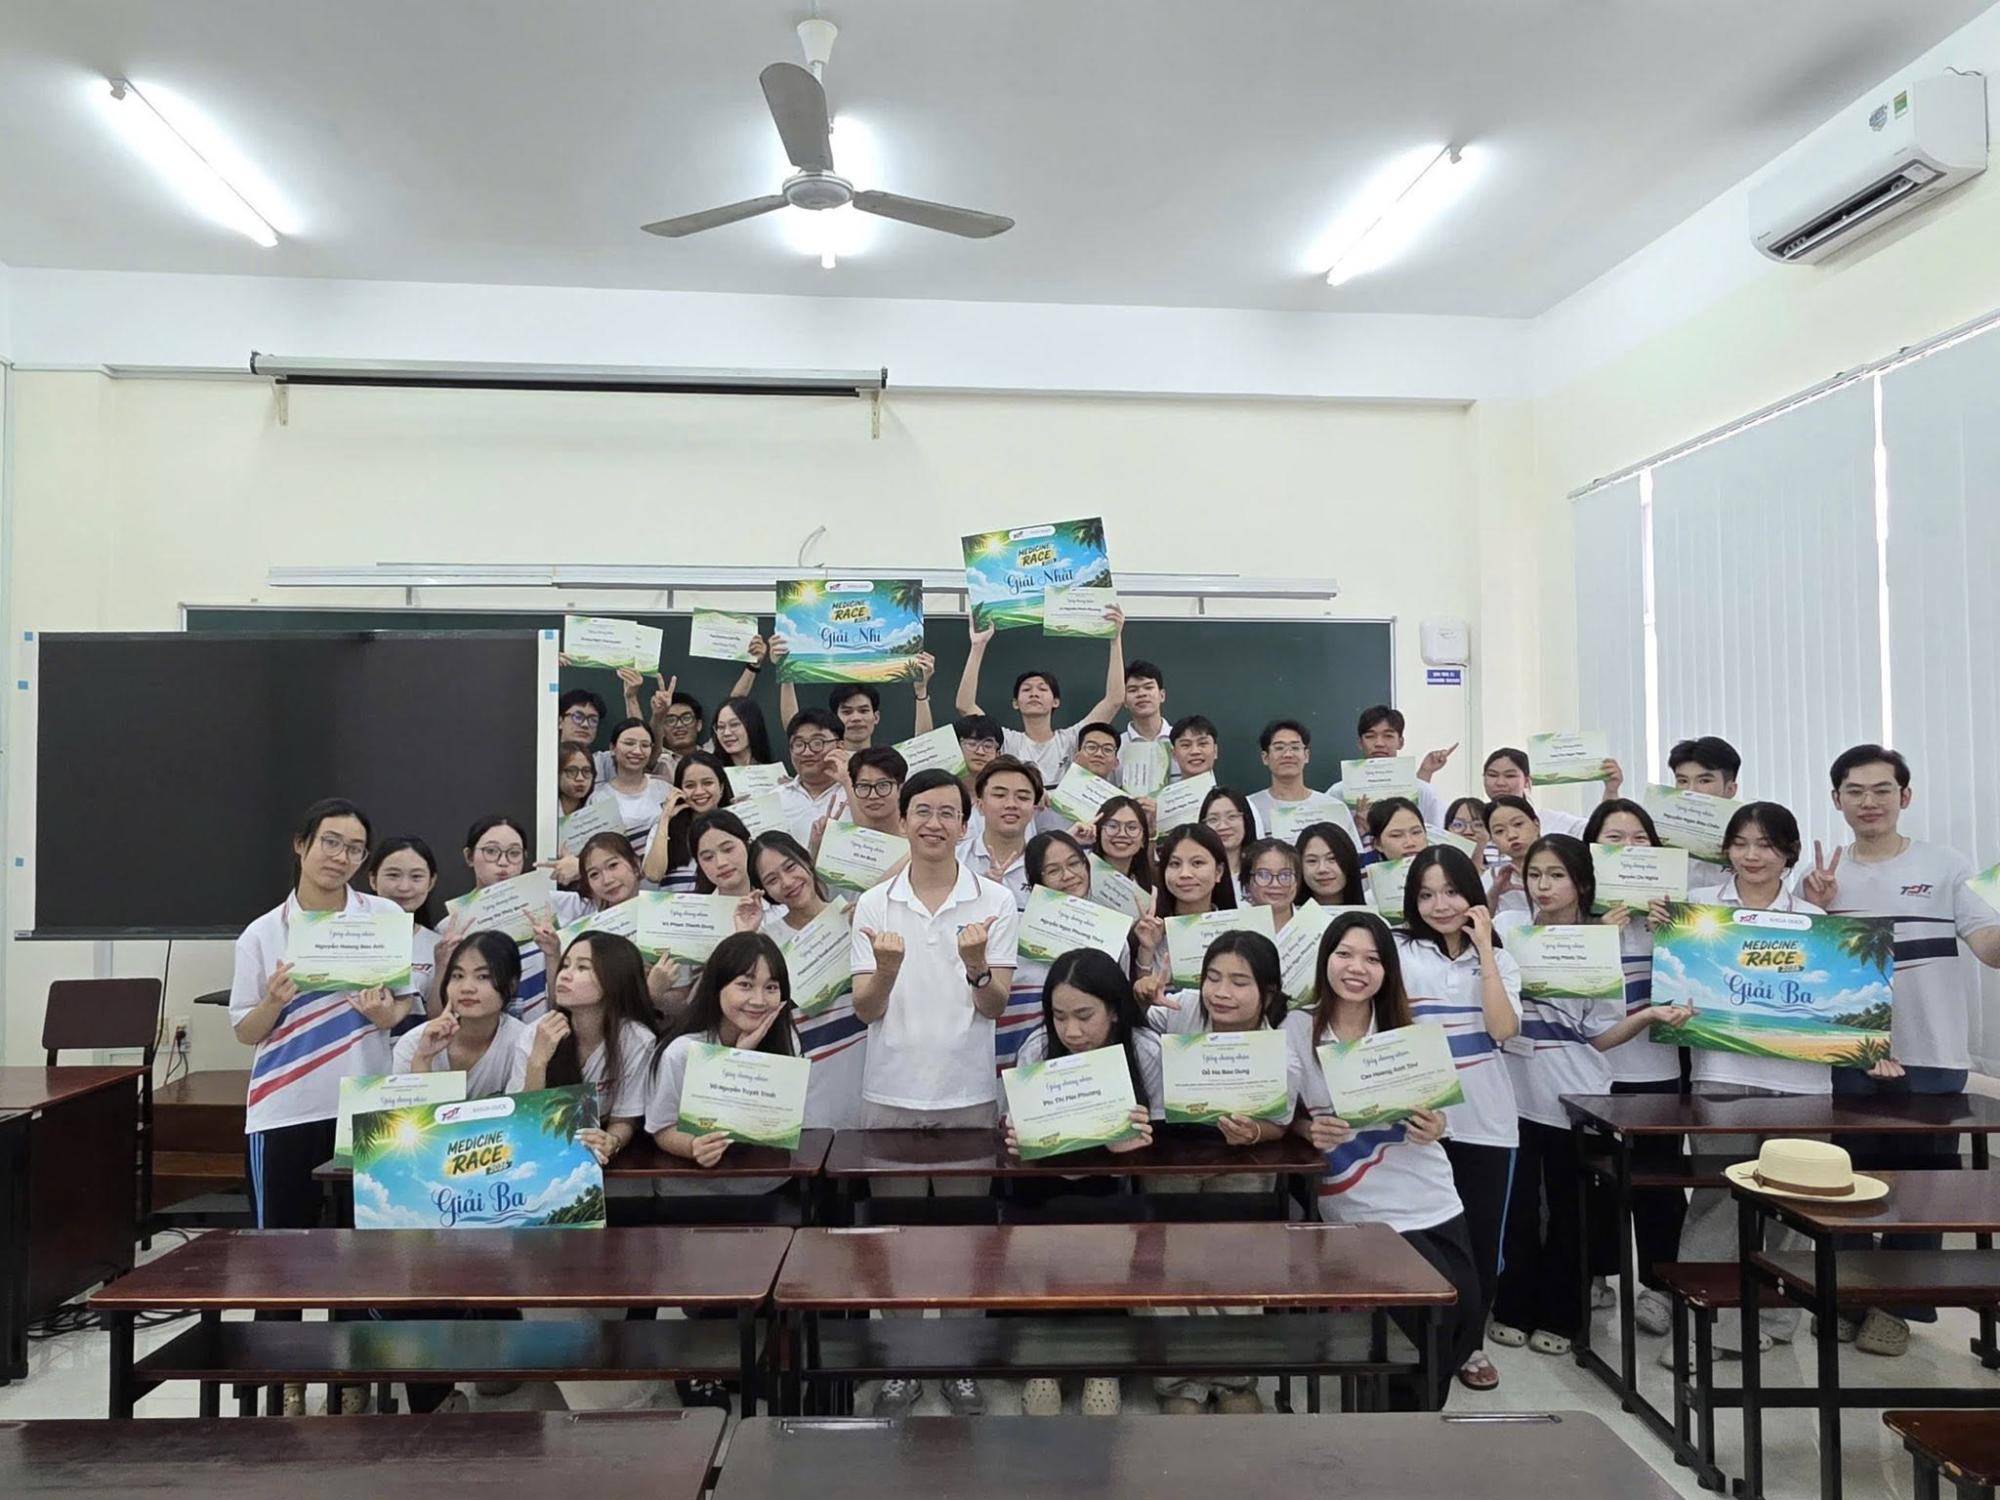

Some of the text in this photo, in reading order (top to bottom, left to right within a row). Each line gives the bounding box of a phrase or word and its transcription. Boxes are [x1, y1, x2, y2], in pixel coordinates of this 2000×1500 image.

[1022, 550, 1052, 566] RACE
[835, 607, 866, 620] RACE
[1742, 940, 1799, 950] MEDICINE
[1745, 951, 1798, 966] RACE
[1723, 974, 1815, 1006] Giải Ba
[447, 1130, 504, 1155] MEDICINE
[451, 1145, 503, 1175] RACE
[431, 1181, 527, 1227] Giải Ba
